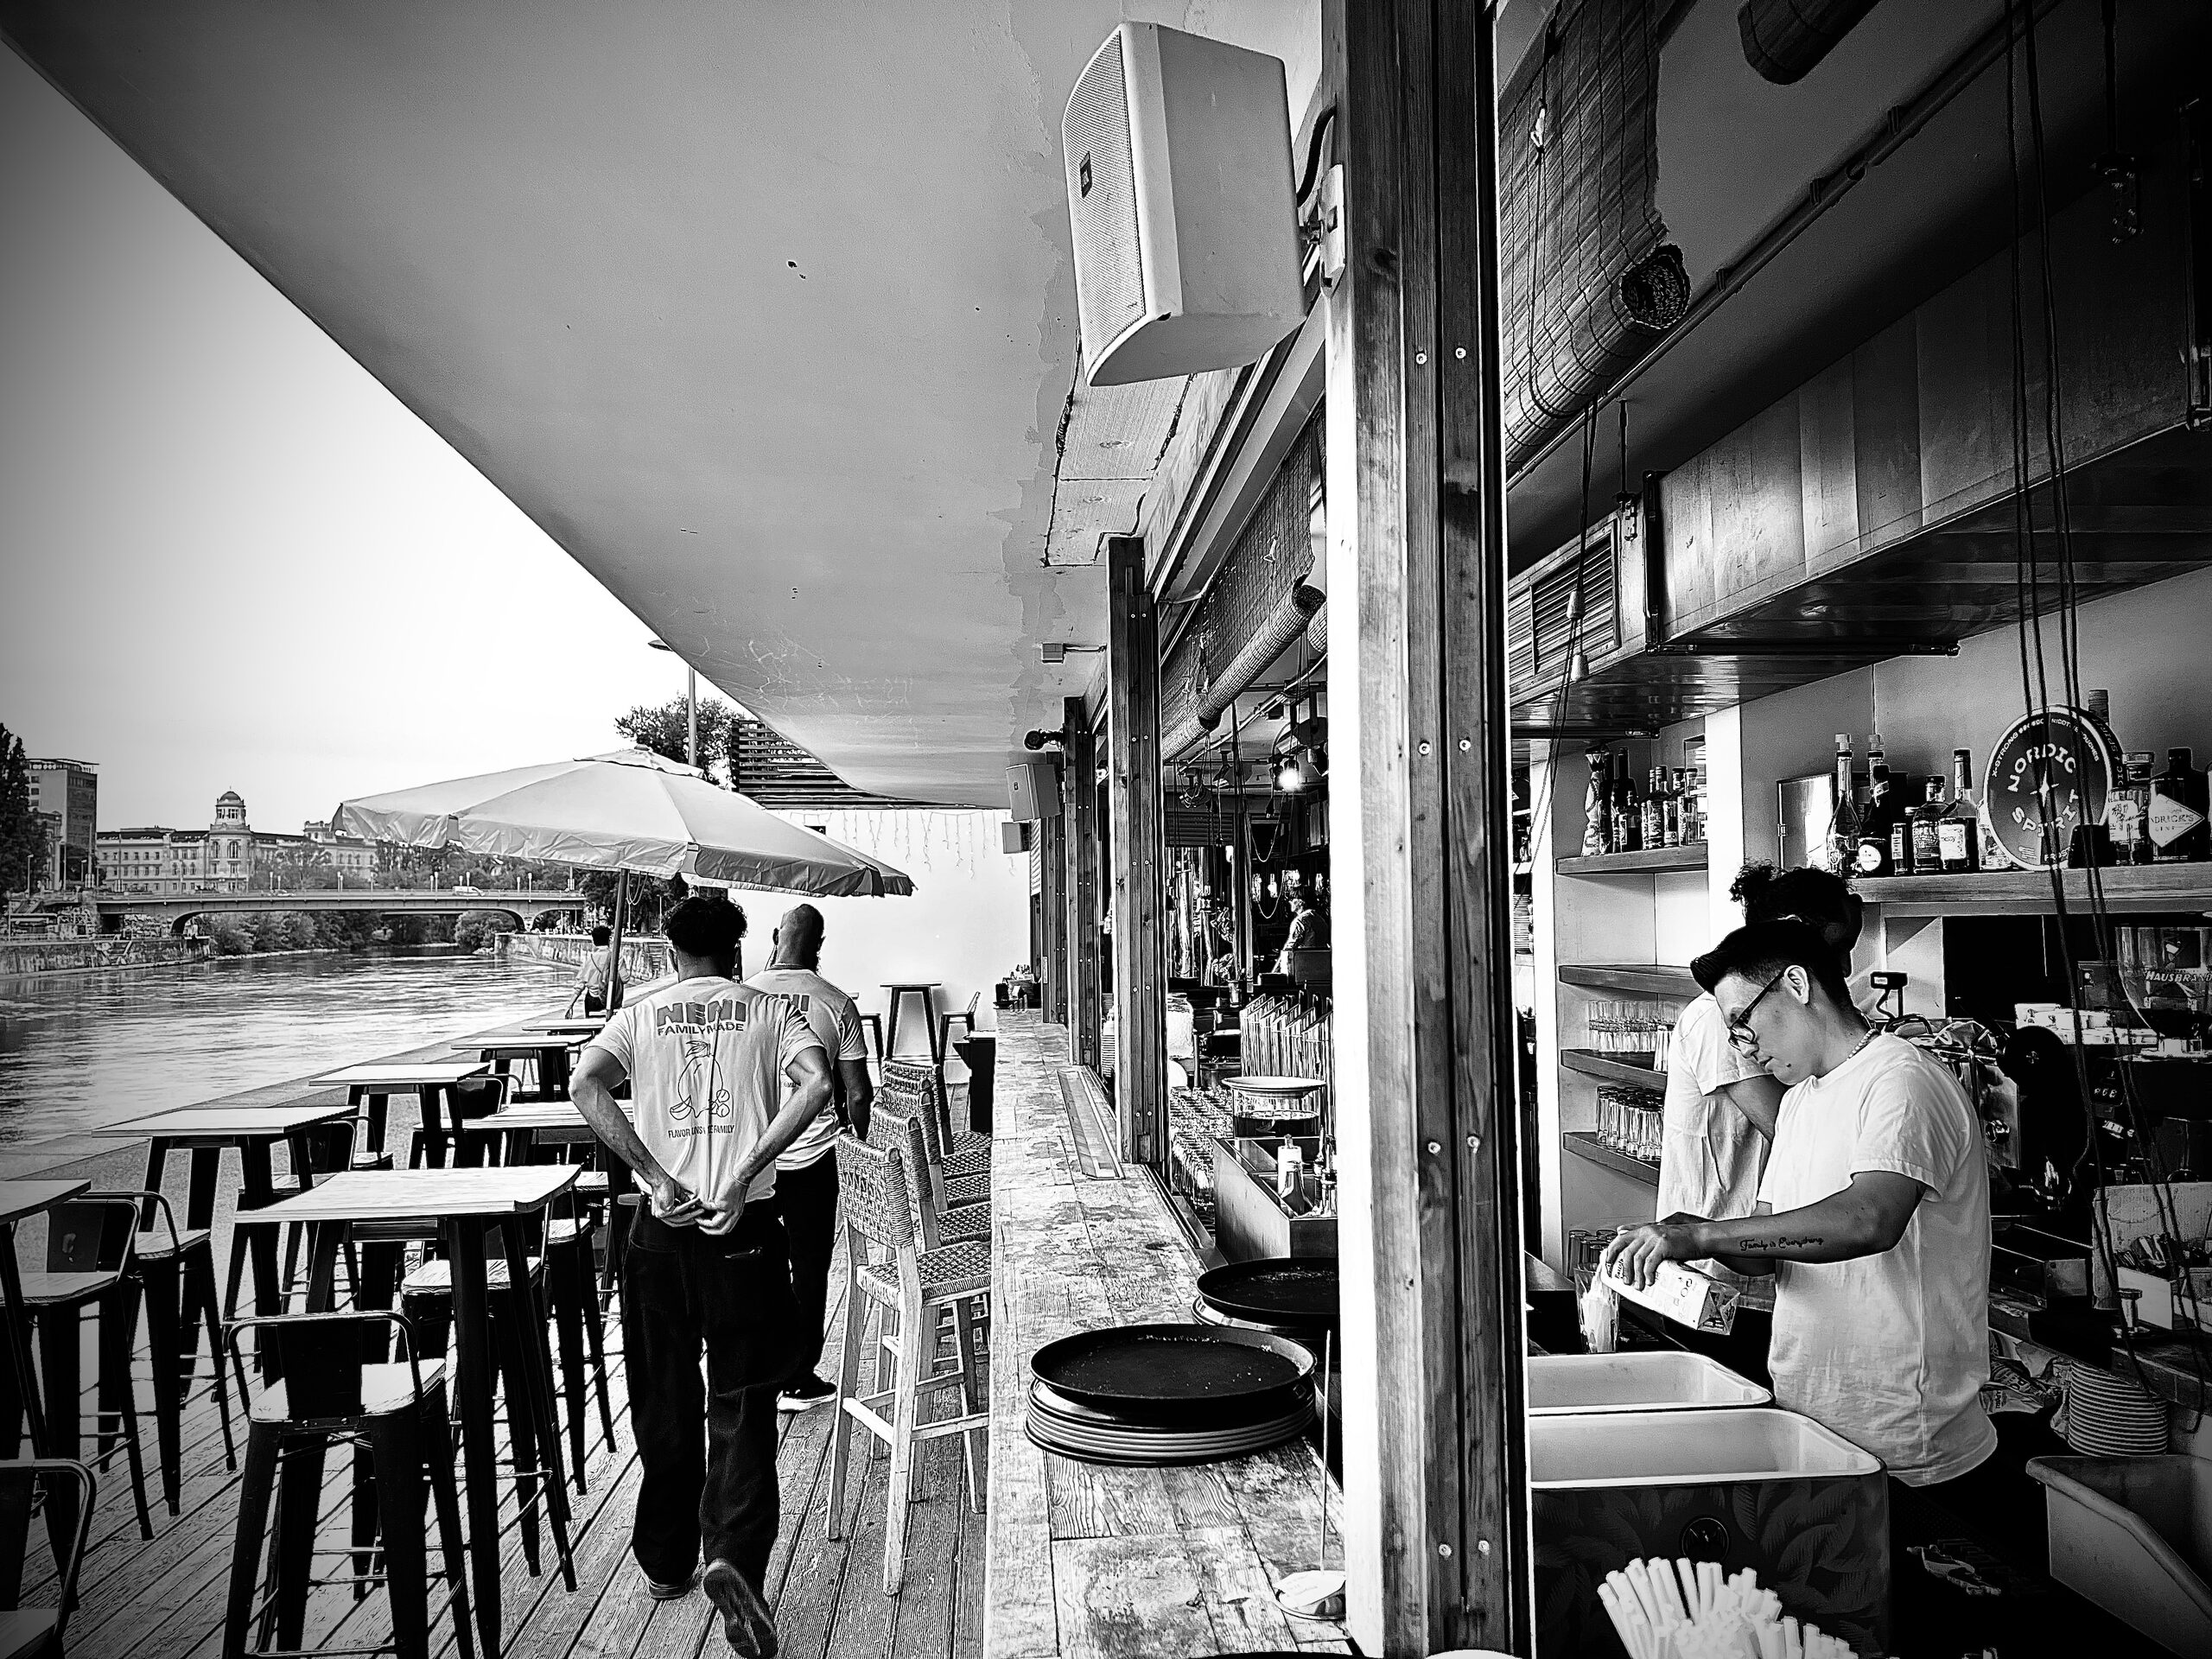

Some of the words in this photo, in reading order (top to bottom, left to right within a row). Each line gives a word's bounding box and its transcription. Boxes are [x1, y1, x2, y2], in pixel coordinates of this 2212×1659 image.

[2007, 743, 2076, 792] NORDIC
[2012, 788, 2079, 837] SPIRIT
[657, 999, 747, 1027] NENI
[1739, 1237, 1769, 1251] Family
